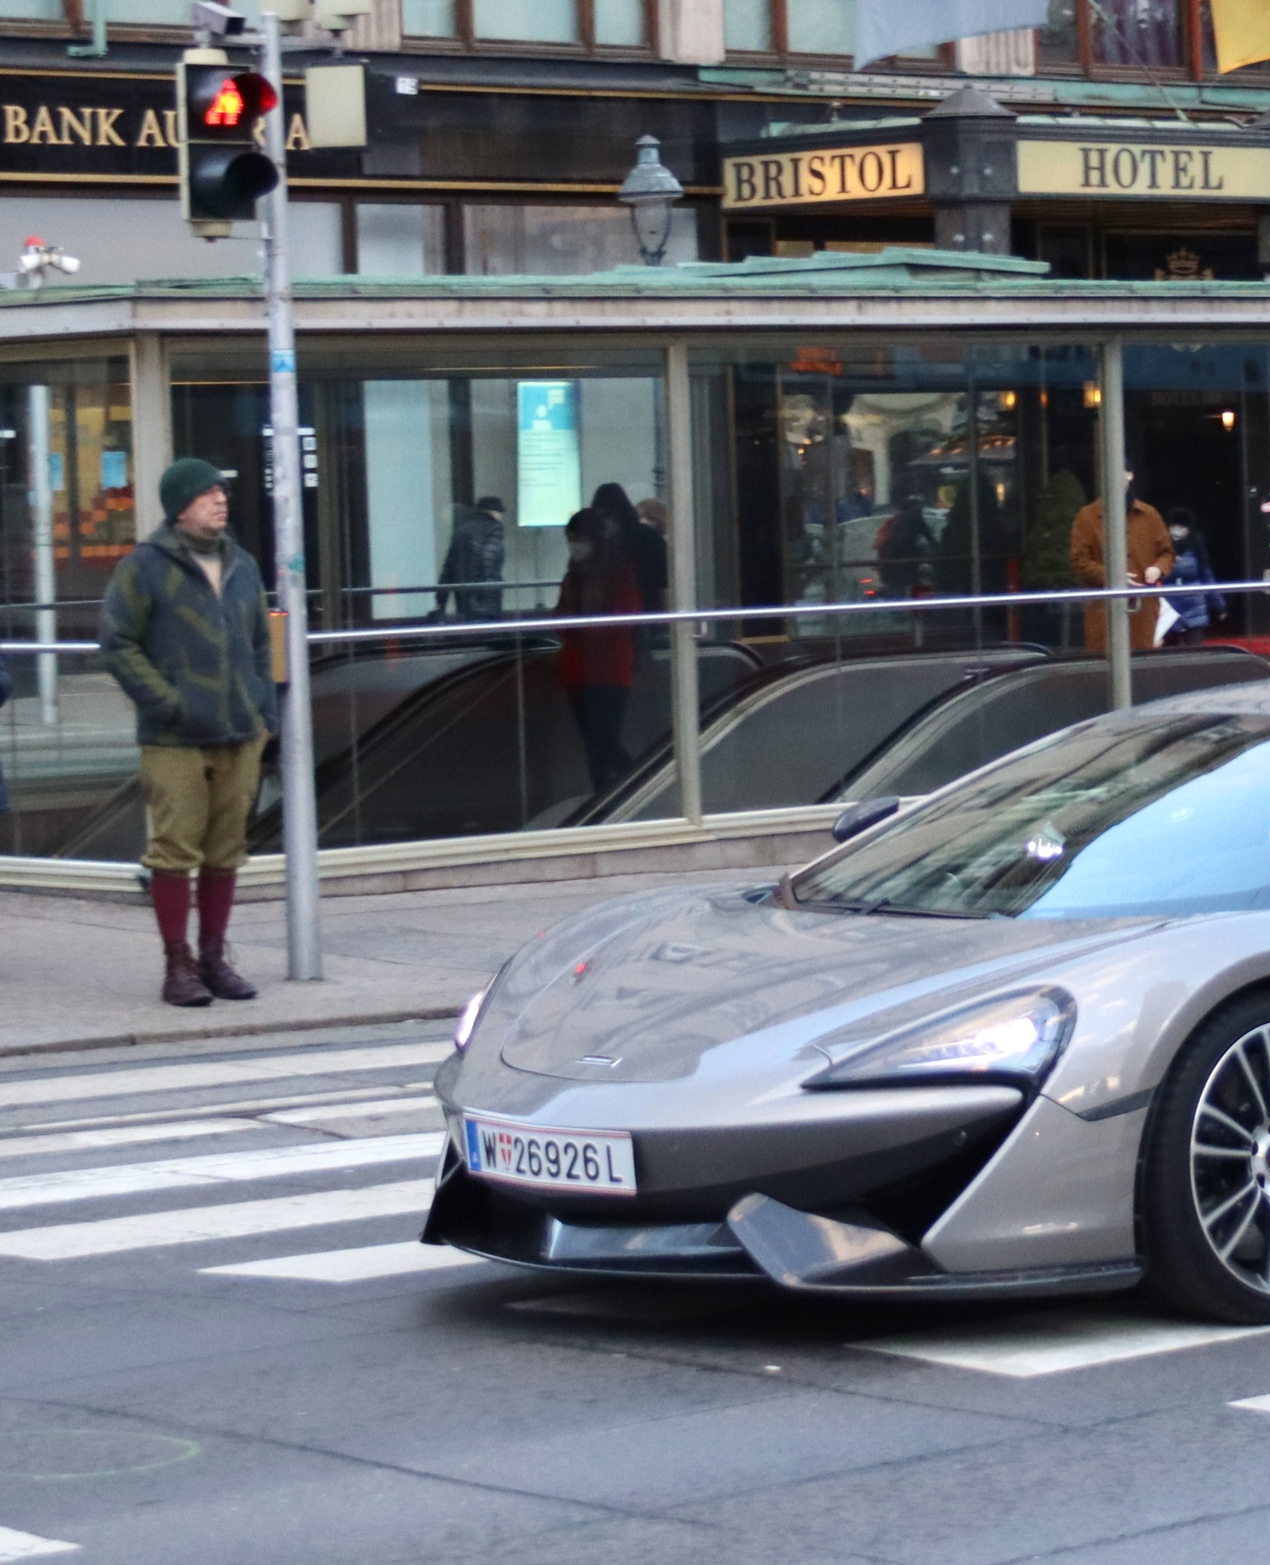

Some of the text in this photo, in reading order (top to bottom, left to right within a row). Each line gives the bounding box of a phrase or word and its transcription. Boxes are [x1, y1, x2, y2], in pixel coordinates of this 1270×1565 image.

[2, 104, 126, 146] BANK
[733, 149, 912, 202] BRISTOL
[1078, 147, 1225, 190] HOTEL
